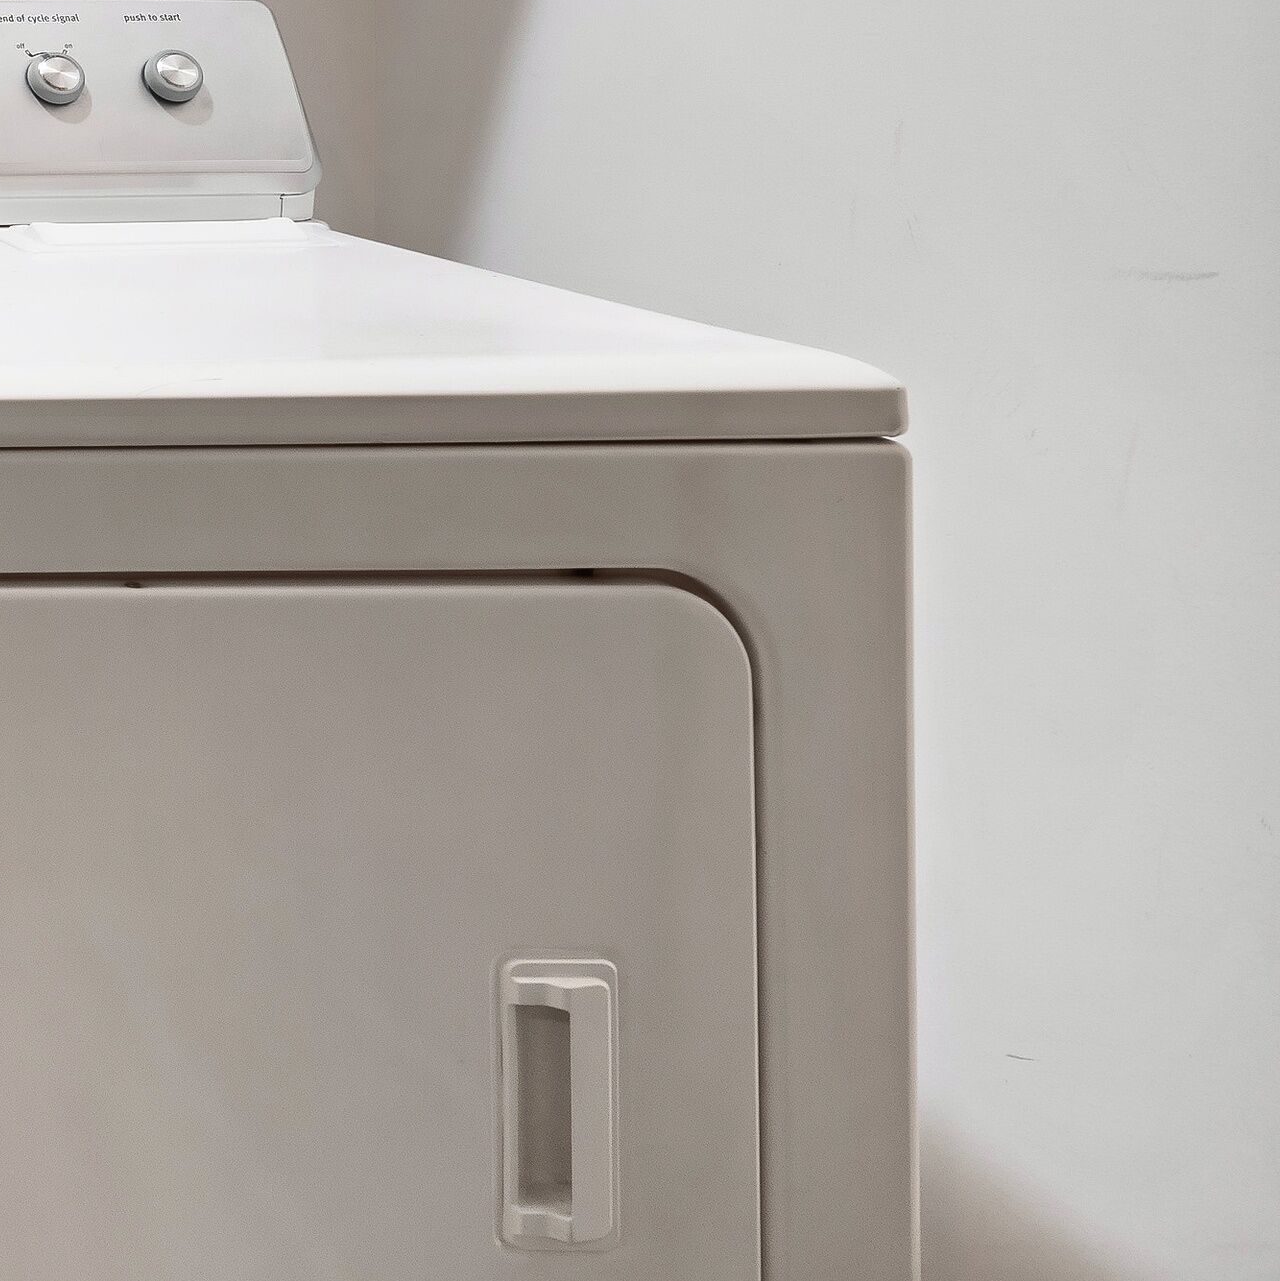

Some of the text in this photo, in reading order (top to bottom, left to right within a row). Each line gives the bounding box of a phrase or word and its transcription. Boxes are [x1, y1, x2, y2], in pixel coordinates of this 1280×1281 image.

[27, 14, 50, 24] cycle
[51, 13, 80, 23] signal
[123, 13, 182, 23] push to start
[16, 42, 25, 50] off
